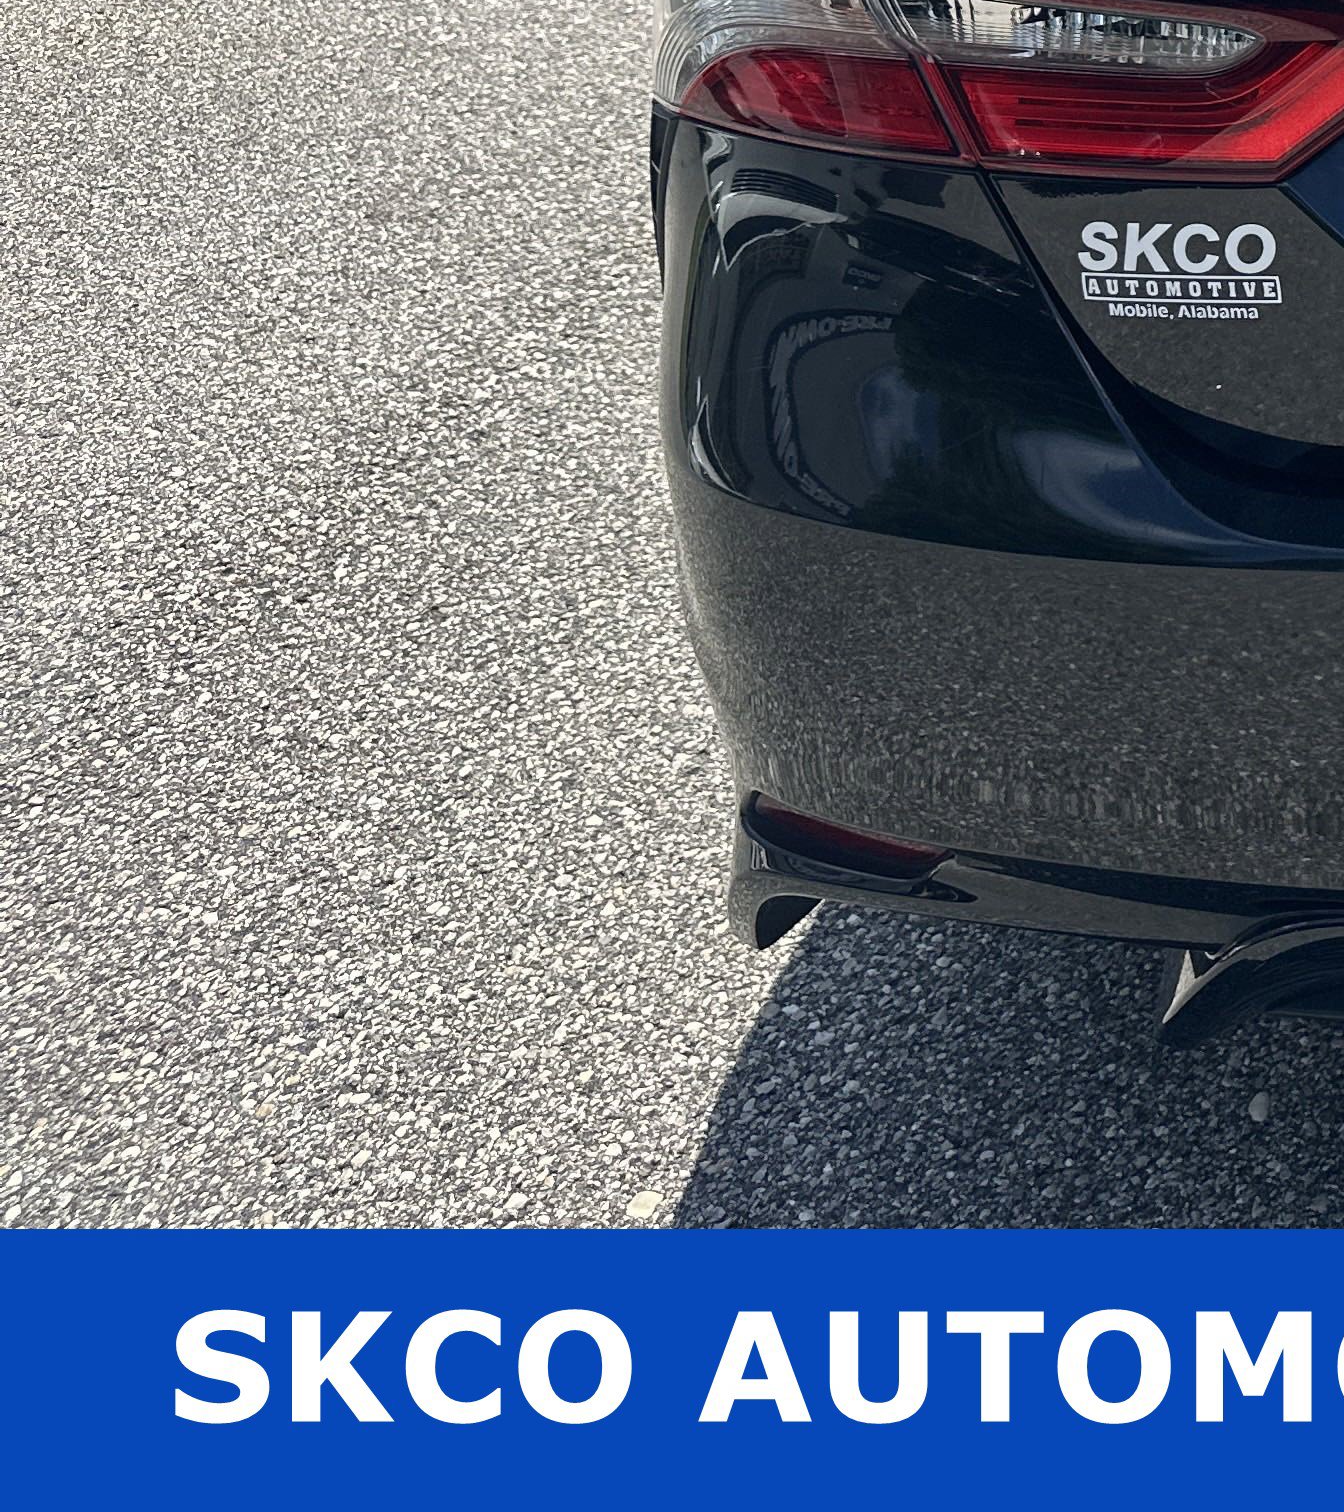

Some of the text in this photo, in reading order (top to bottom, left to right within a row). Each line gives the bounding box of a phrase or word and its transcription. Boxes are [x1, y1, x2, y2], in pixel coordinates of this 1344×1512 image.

[1078, 221, 1277, 274] SKCO
[1087, 278, 1277, 298] AUTOMOTIVE
[1178, 304, 1259, 319] Alabama
